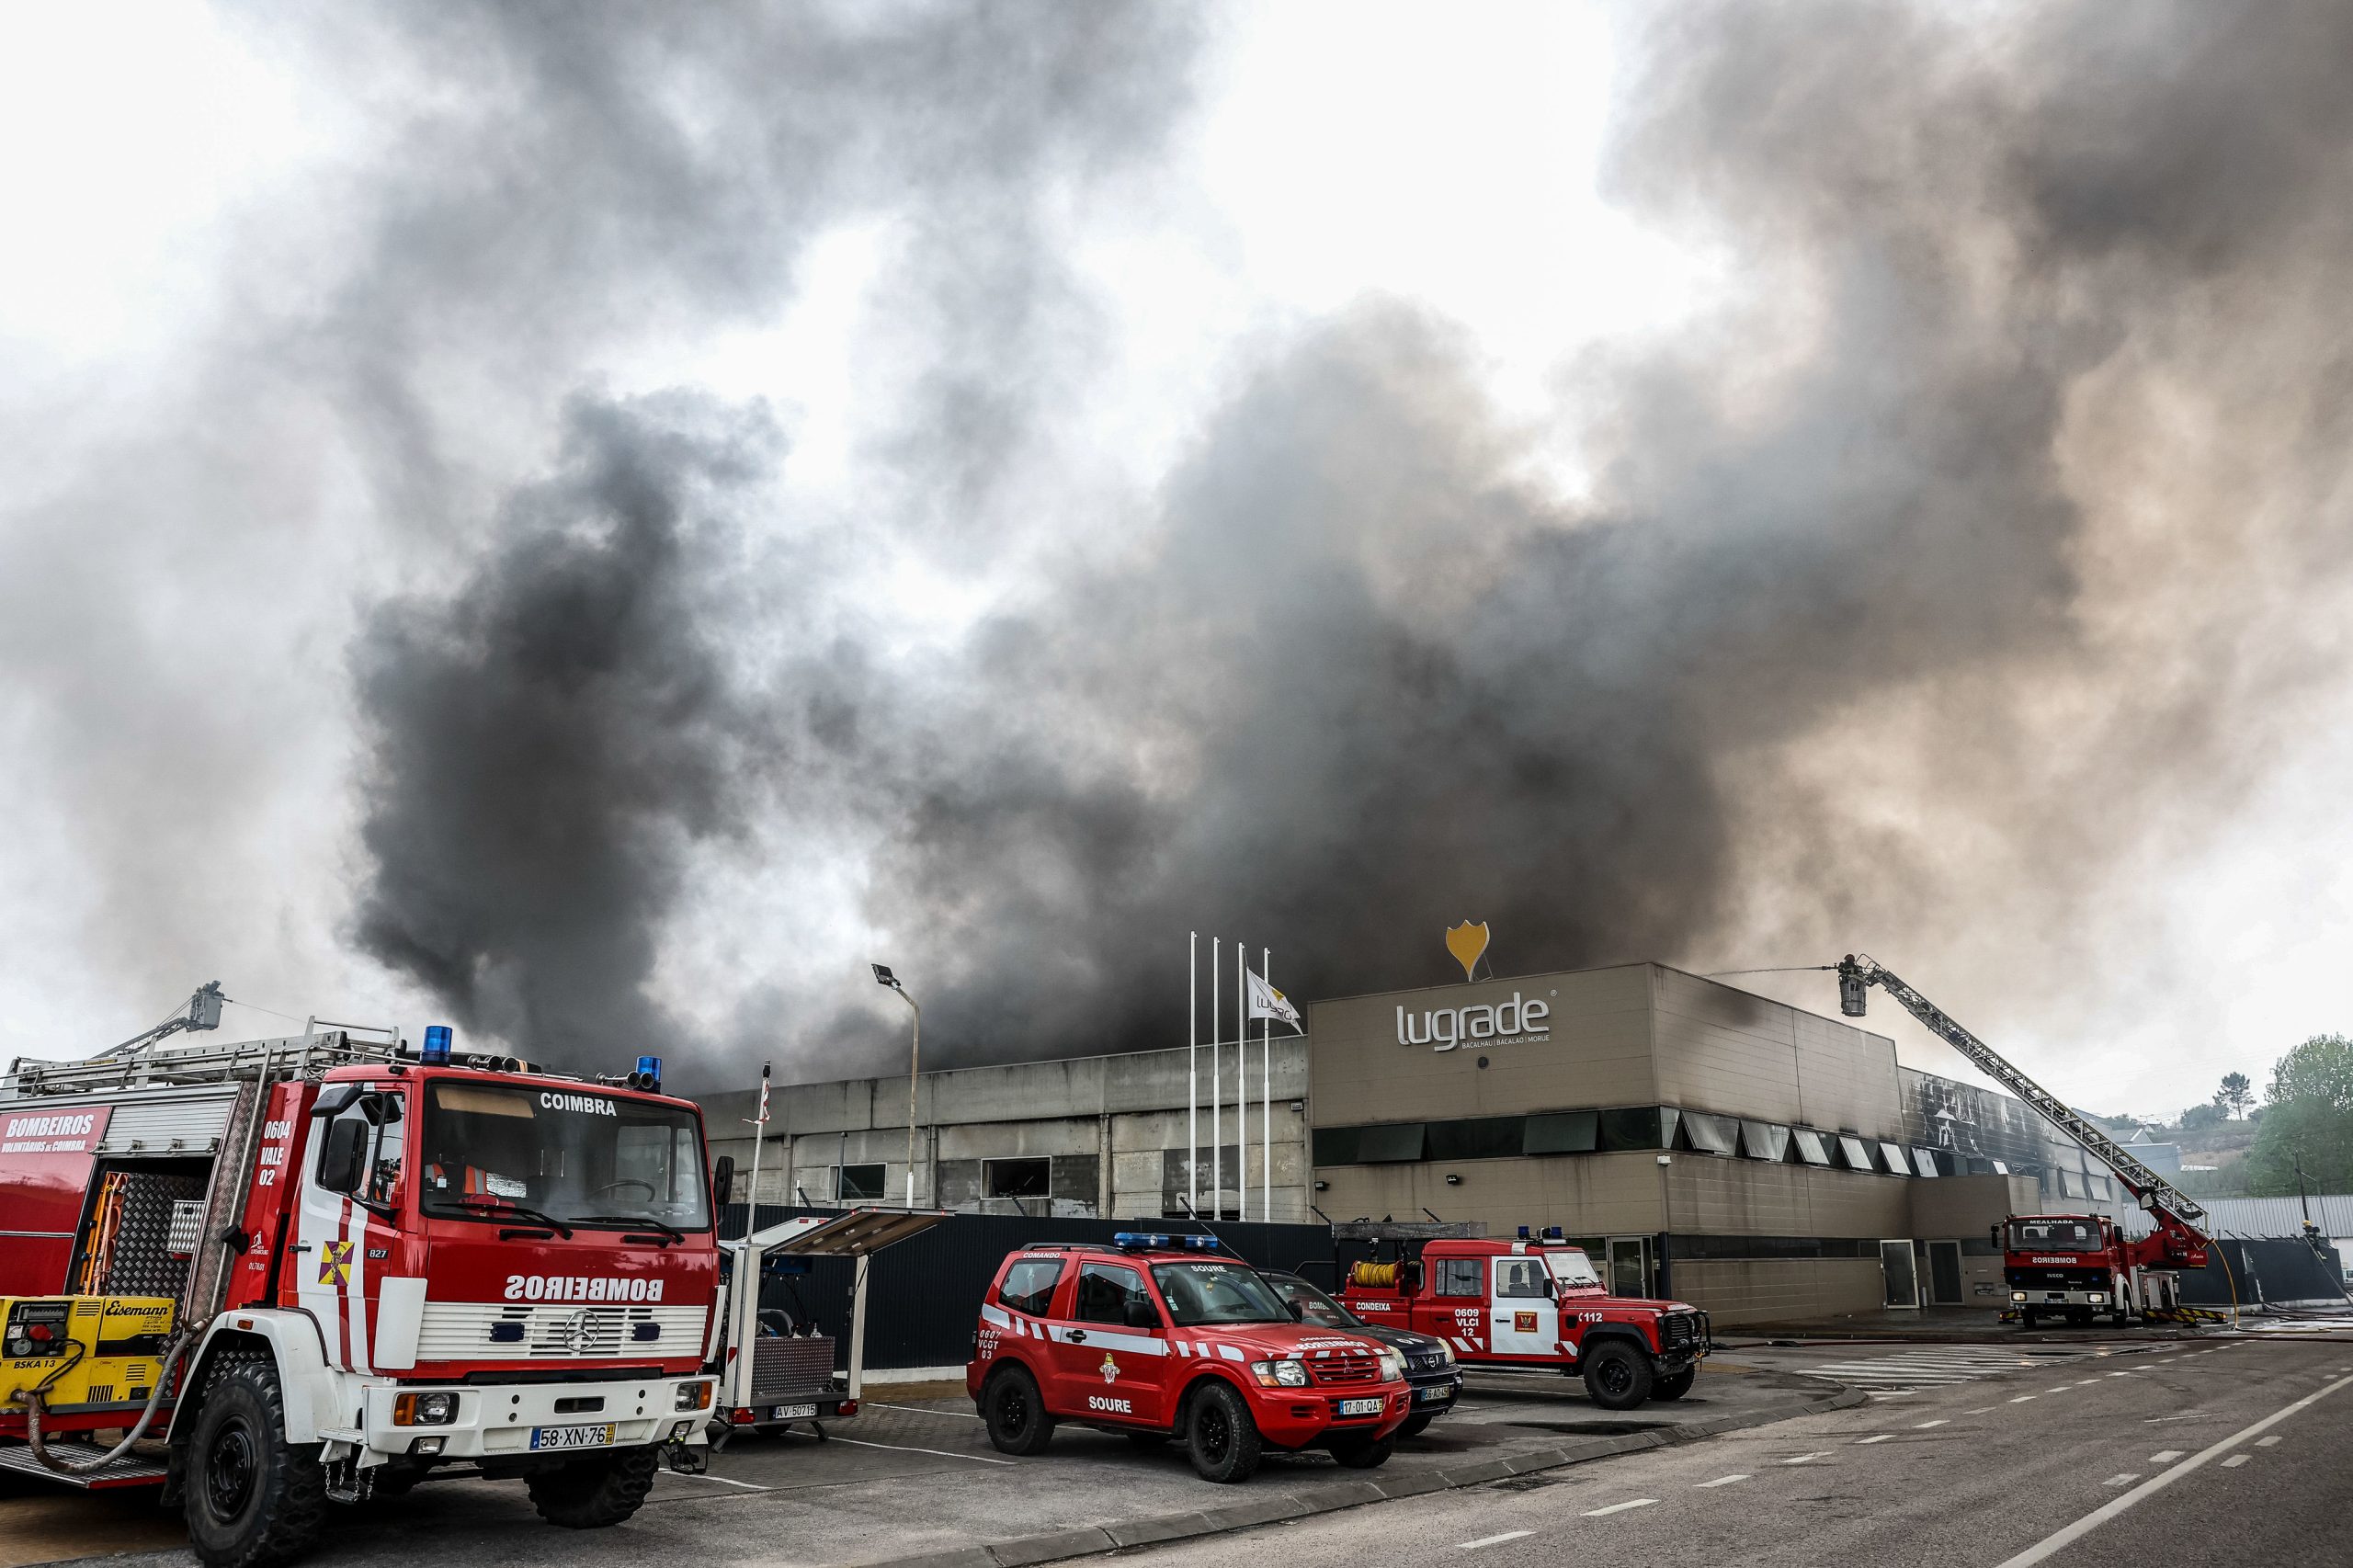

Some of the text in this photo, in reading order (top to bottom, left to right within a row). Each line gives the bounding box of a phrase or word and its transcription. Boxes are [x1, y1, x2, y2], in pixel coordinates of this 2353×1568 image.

[1396, 992, 1550, 1051] lugrade
[1461, 1034, 1551, 1050] BACALHAU BACALAO MORUE
[540, 1092, 618, 1117] COIMBRA
[5, 1114, 95, 1138] BOMBEIROS
[263, 1120, 292, 1140] 0604
[1, 1140, 47, 1153] VOLUNTÁRIOS
[51, 1140, 86, 1152] COIMBRA
[260, 1146, 285, 1165] VALE
[258, 1168, 276, 1186] 02
[1190, 1265, 1228, 1273] SOURE
[105, 1301, 168, 1316] Eisemann
[1356, 1301, 1392, 1312] CONDEIXA
[1454, 1308, 1480, 1317] 0609
[1456, 1318, 1480, 1327] VLCI
[1584, 1312, 1603, 1323] 112
[979, 1329, 1002, 1340] 0607
[1461, 1327, 1474, 1337] 12
[982, 1350, 993, 1360] 03
[13, 1360, 41, 1369] BSKA
[776, 1404, 815, 1417] AV-50715
[1088, 1395, 1132, 1414] SOURE
[1344, 1400, 1379, 1414] 17-01-QA
[540, 1426, 607, 1448] 58-XN-76
